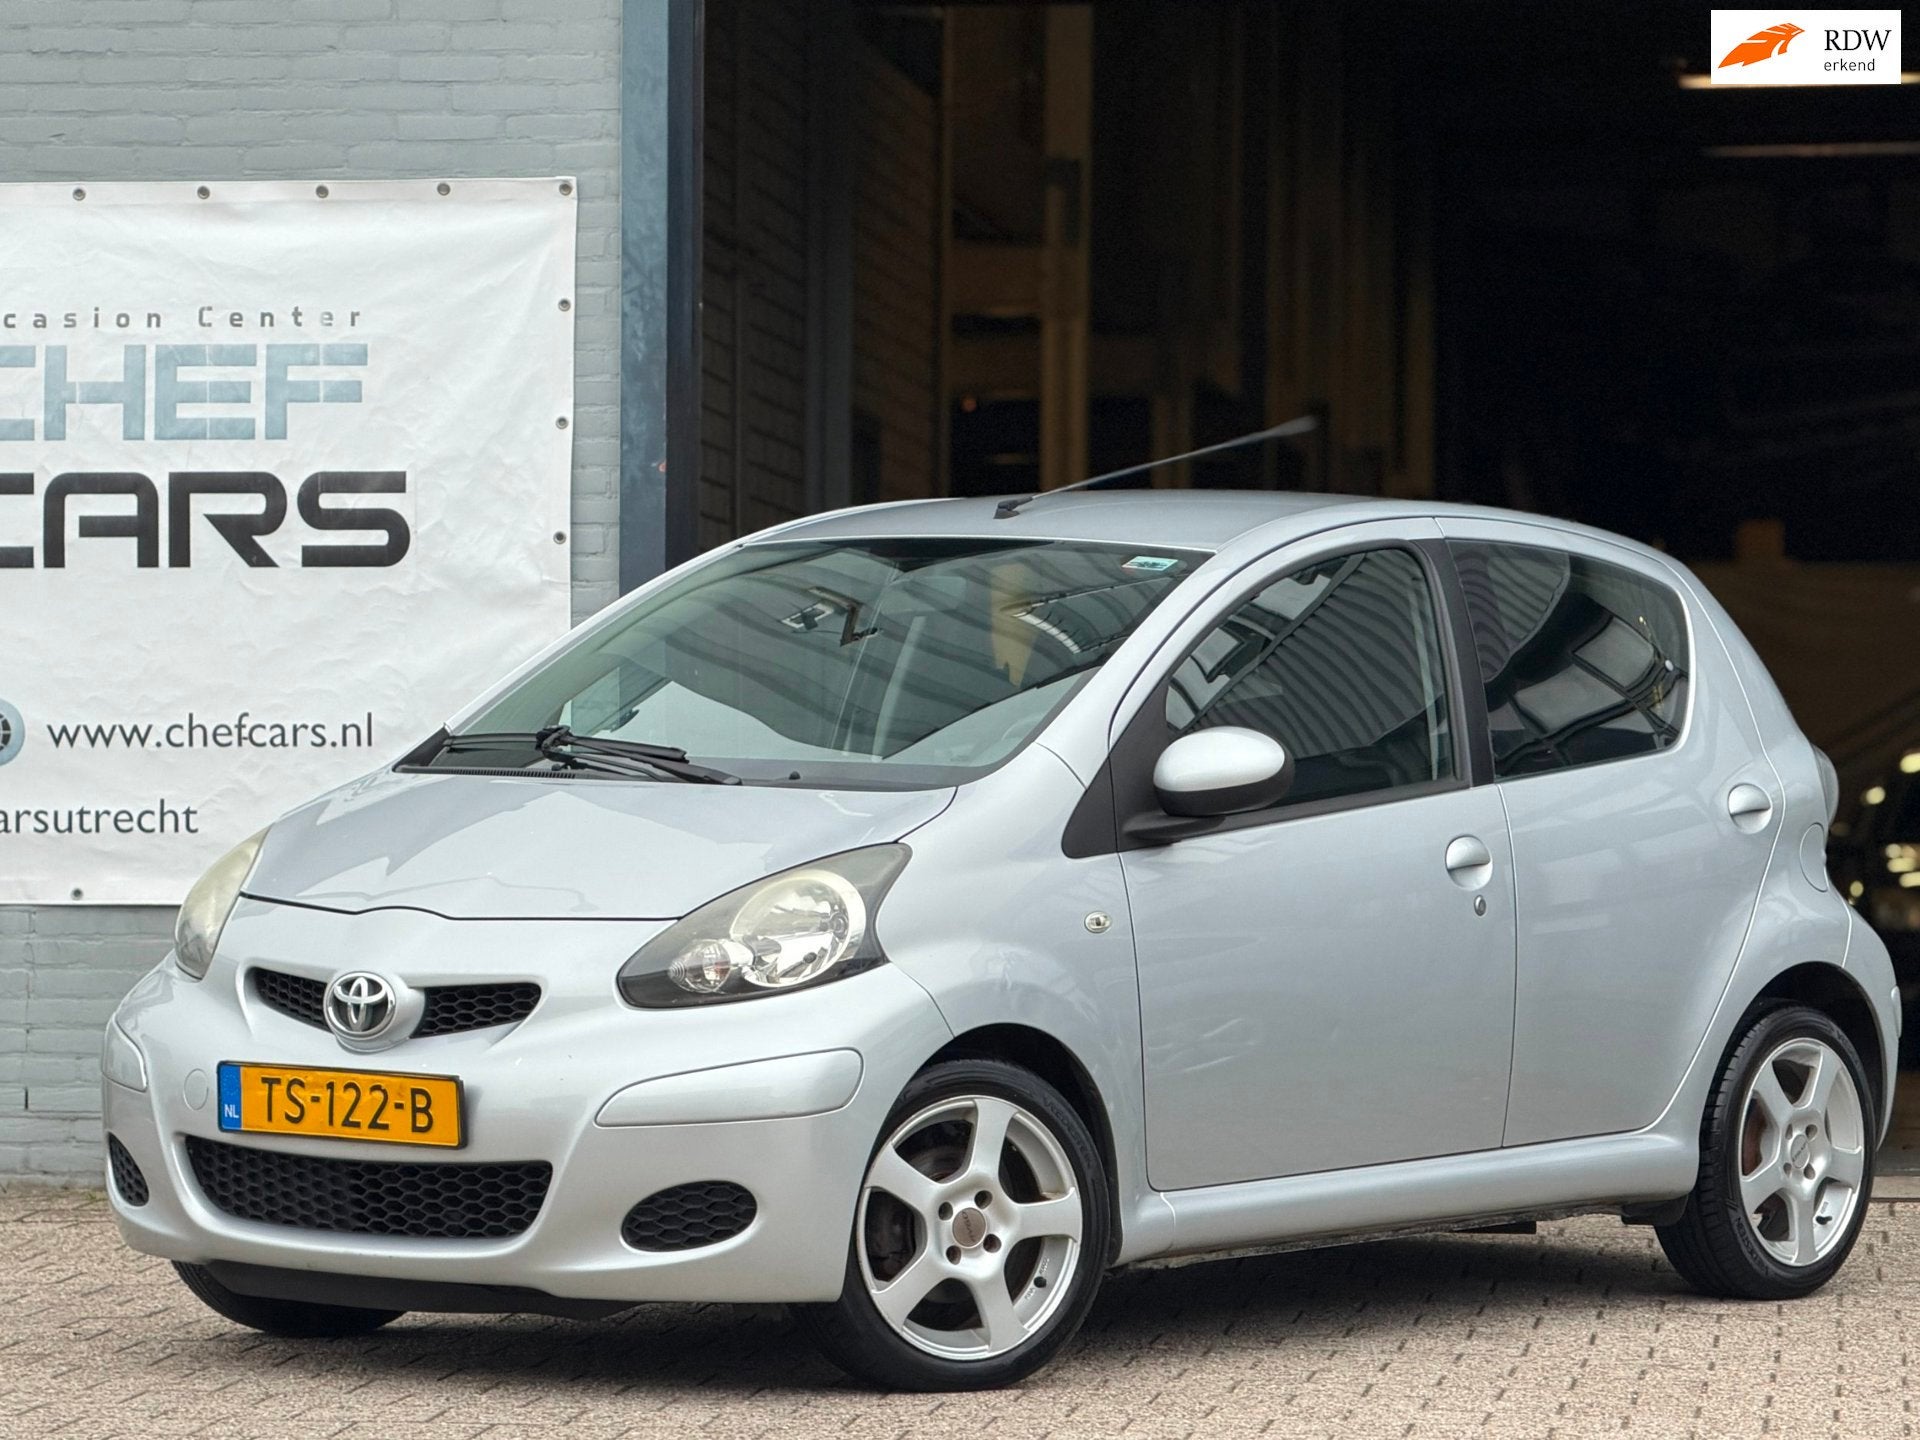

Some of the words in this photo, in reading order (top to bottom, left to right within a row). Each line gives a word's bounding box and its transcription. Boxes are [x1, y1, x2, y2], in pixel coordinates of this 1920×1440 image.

[3, 307, 161, 329] casion
[198, 306, 361, 328] Center
[46, 711, 373, 748] www.chefcars.nl
[224, 1104, 240, 1119] NL
[261, 1077, 434, 1133] TS-122-B
